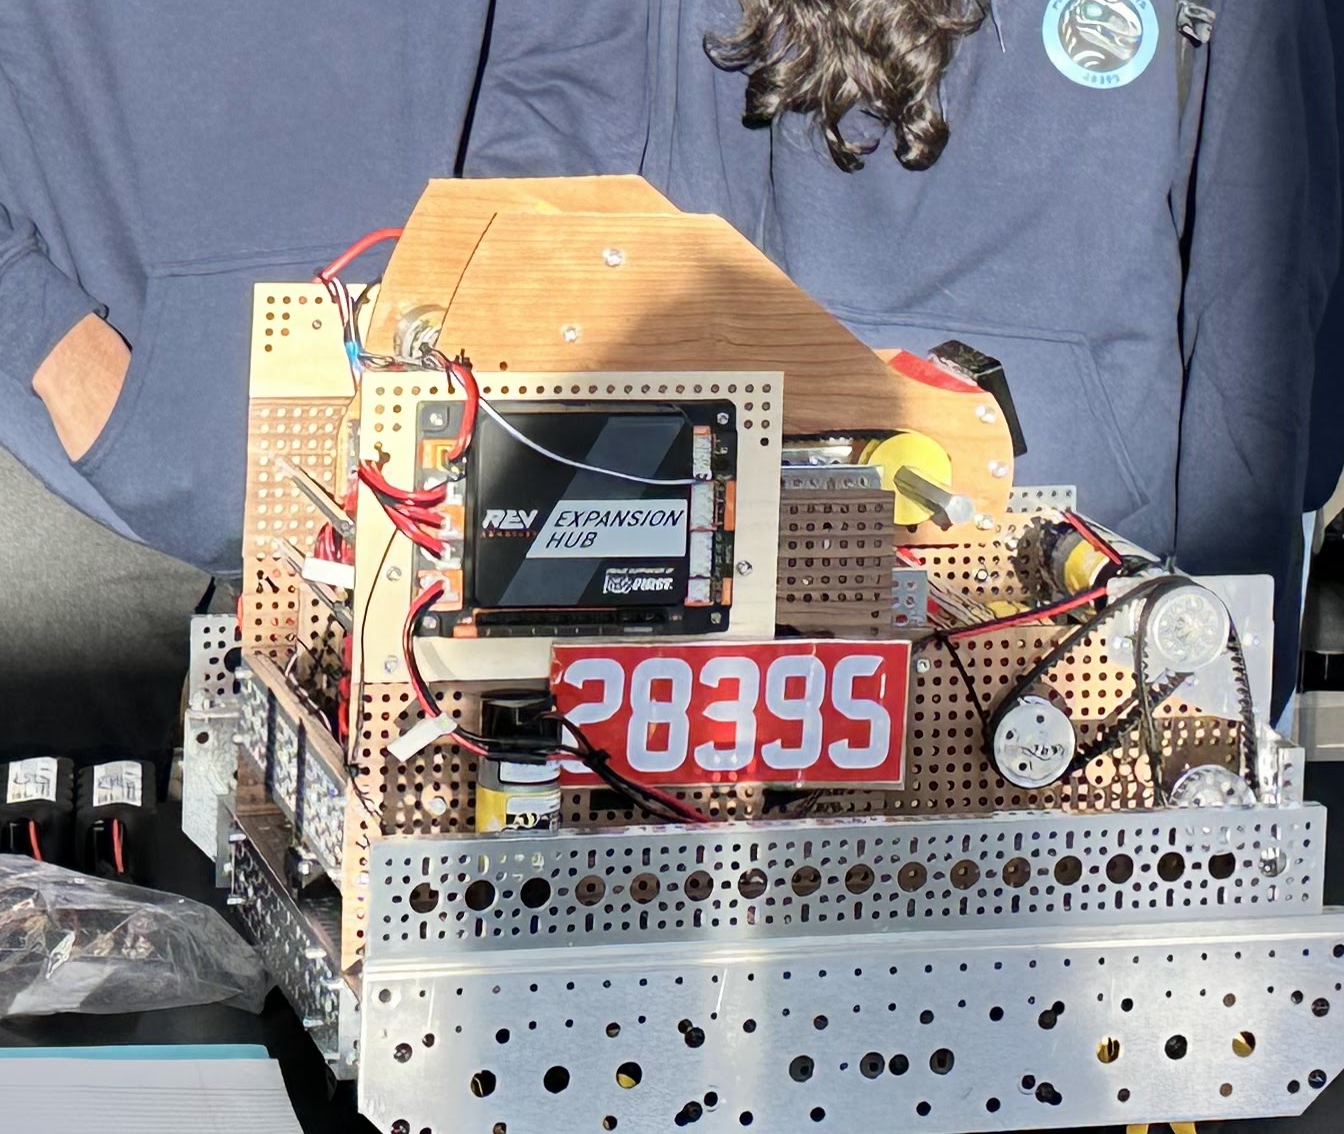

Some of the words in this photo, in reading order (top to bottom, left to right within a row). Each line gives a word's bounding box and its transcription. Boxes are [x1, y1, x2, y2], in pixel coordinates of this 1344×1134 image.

[481, 509, 539, 530] REV
[553, 509, 685, 528] EXPANSION
[545, 531, 598, 549] HUB
[560, 654, 892, 774] 28395
